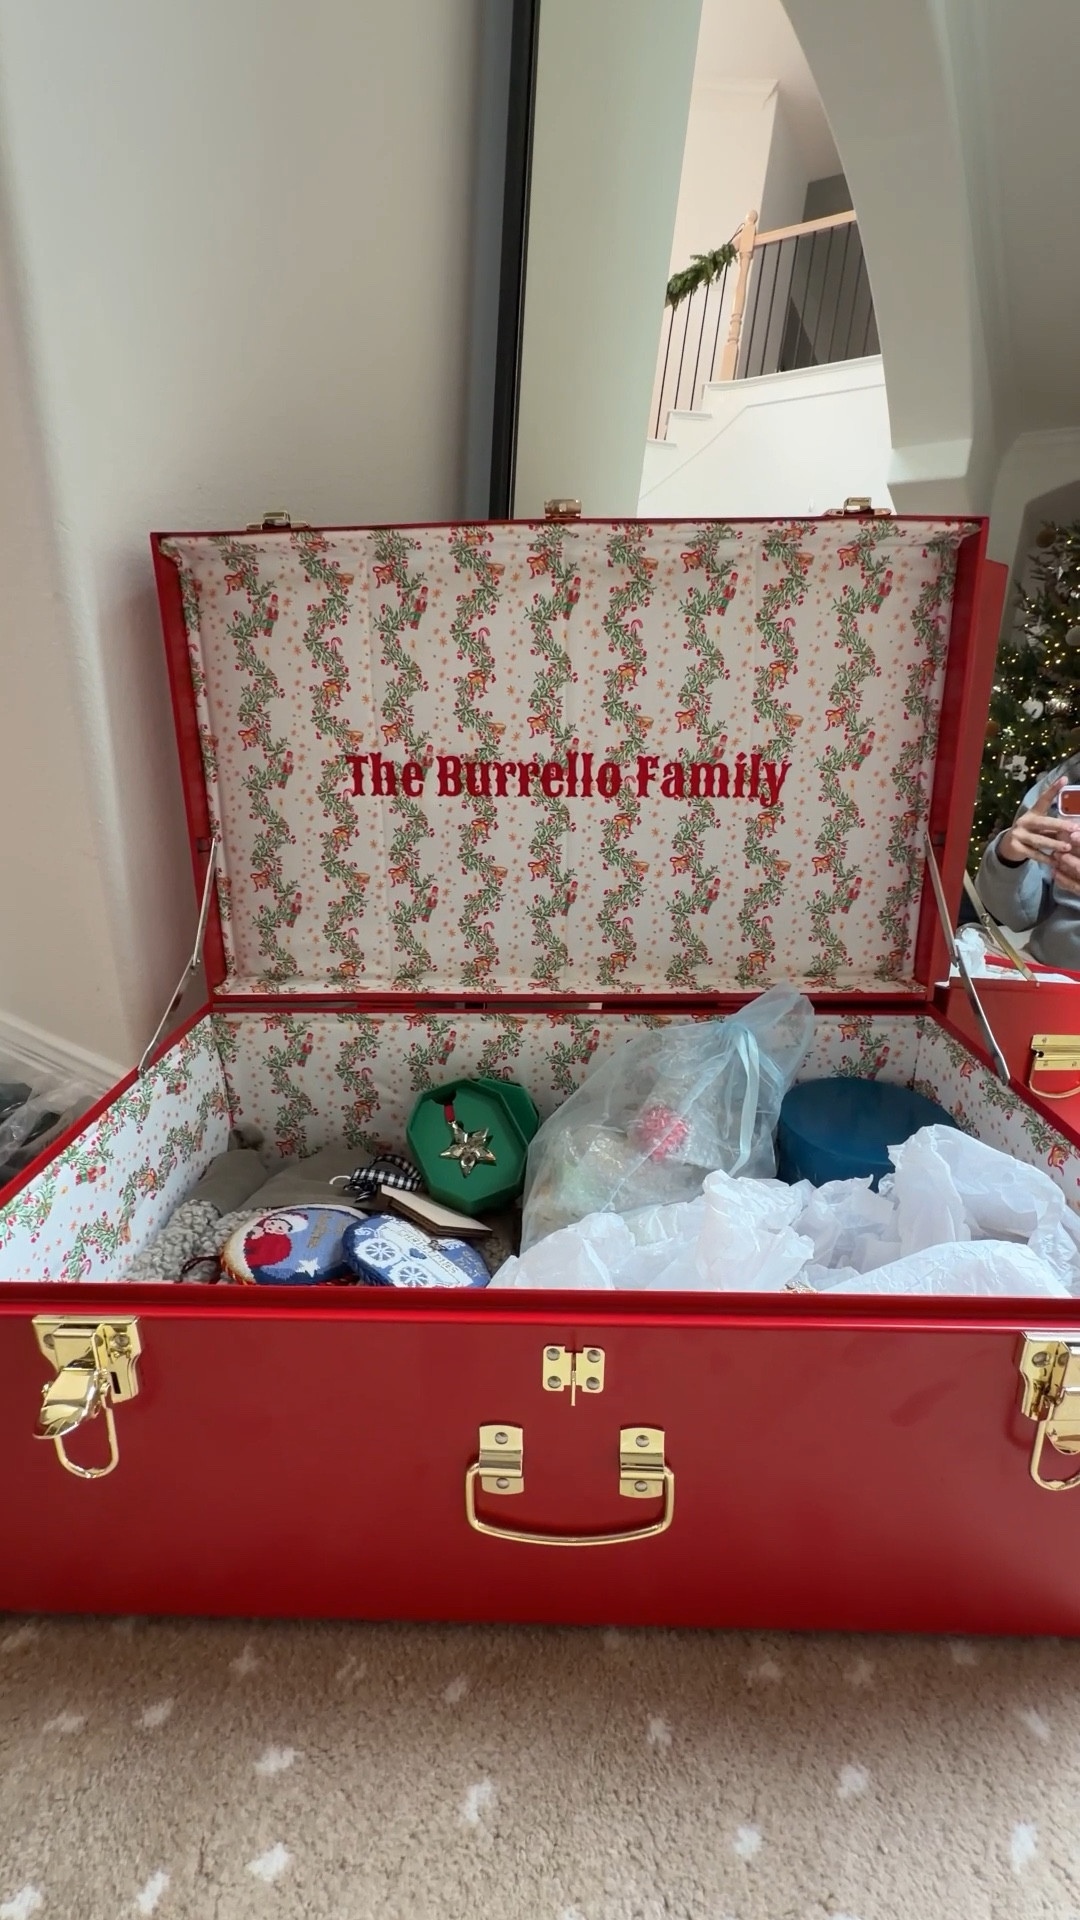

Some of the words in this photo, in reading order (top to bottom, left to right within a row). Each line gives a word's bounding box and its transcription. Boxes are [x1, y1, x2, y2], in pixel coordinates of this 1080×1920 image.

[345, 751, 425, 797] The
[436, 751, 623, 798] Burrello
[636, 751, 793, 808] Family
